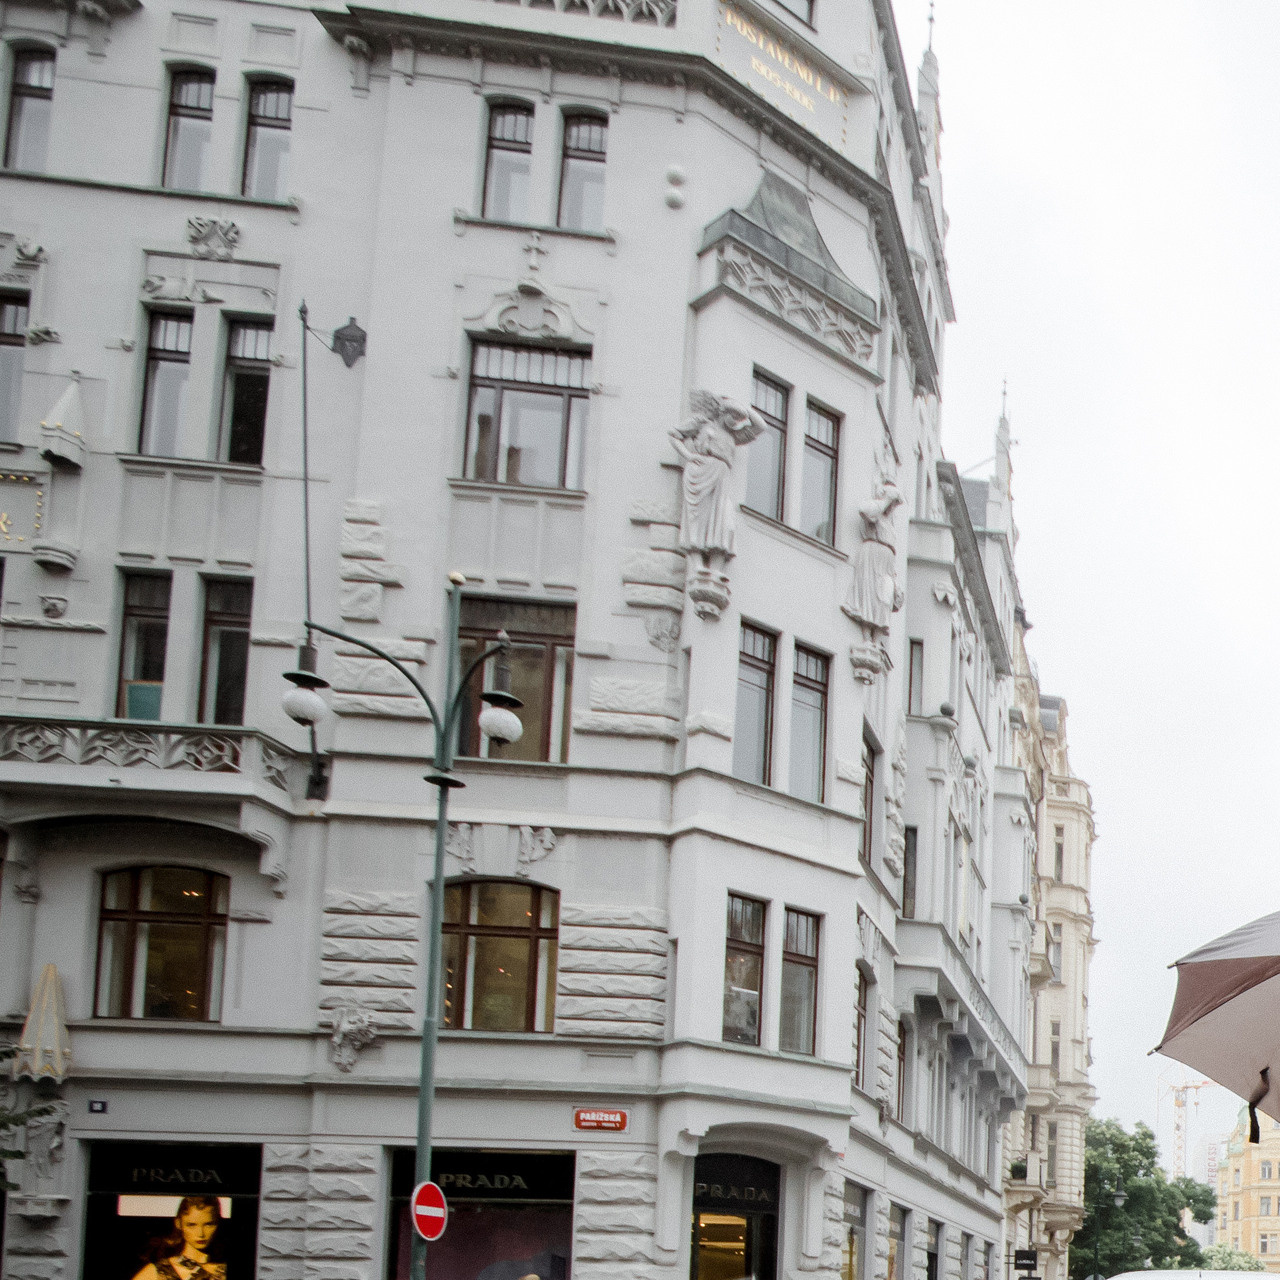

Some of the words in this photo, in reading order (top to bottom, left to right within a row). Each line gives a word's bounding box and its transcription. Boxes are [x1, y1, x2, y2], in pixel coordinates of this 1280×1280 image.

[132, 1168, 222, 1184] PRADA
[439, 1173, 529, 1190] PRADA
[695, 1183, 770, 1202] PRADA
